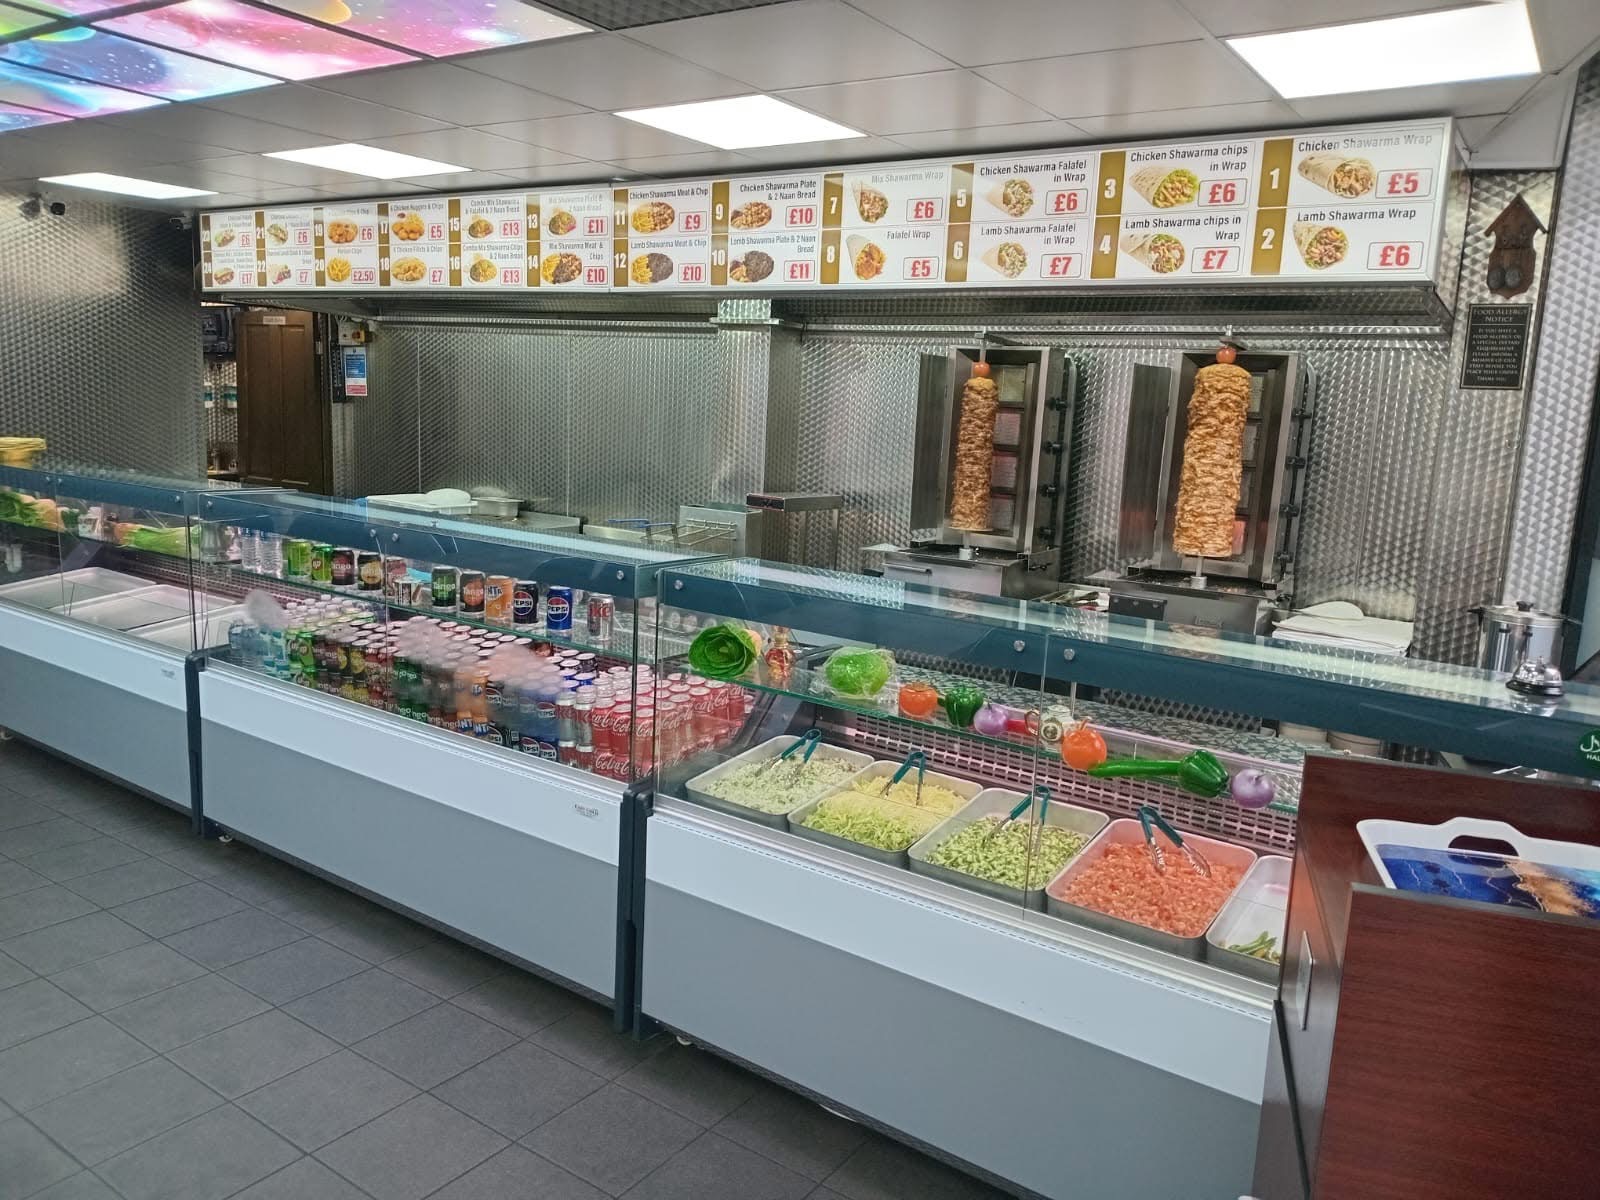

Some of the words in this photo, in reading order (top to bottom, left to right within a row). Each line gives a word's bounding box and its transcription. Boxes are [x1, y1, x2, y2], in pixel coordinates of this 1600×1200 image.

[1298, 141, 1340, 152] Chicken
[1344, 137, 1400, 149] Shawarma
[1404, 135, 1432, 146] Wrap
[1130, 152, 1167, 162] Chicken
[1169, 149, 1218, 160] Shawarma
[1222, 145, 1248, 156] chips
[980, 166, 1011, 176] Chicken
[1013, 164, 1056, 174] Shawarma
[1058, 160, 1087, 170] Falafel
[1210, 162, 1218, 171] in
[1222, 161, 1246, 172] Wrap
[872, 175, 884, 184] Mix
[886, 172, 923, 182] Shawarma
[925, 171, 944, 181] Wrap
[1054, 174, 1062, 182] in
[1064, 173, 1086, 183] Wrap
[1269, 168, 1280, 188] 1
[1388, 172, 1419, 194] £5
[740, 184, 764, 192] Chicken
[766, 182, 799, 191] Shawarma
[800, 180, 816, 188] Plate
[1104, 178, 1117, 199] 3
[1208, 183, 1236, 203] £6
[630, 192, 650, 200] Chicken
[650, 190, 676, 198] Shawarma
[678, 188, 690, 196] Meat
[690, 188, 694, 196] &
[696, 188, 708, 196] Chip
[780, 192, 796, 200] Naan
[797, 190, 816, 199] Bread
[956, 189, 967, 208] 5
[830, 197, 838, 214] 7
[1054, 192, 1078, 212] £6
[715, 203, 724, 220] 9
[790, 208, 813, 225] £10
[914, 201, 934, 219] £6
[1297, 211, 1325, 222] Lamb
[1328, 210, 1384, 221] Shawarma
[1388, 208, 1416, 219] Wrap
[449, 217, 460, 232] 15
[527, 214, 538, 228] 13
[615, 210, 626, 225] 11
[685, 214, 700, 230] £9
[1125, 220, 1150, 229] Lamb
[1152, 218, 1201, 228] Shawarma
[1203, 215, 1229, 227] chips
[1232, 215, 1241, 224] in
[256, 227, 264, 239] 21
[314, 224, 323, 236] 19
[431, 225, 442, 238] £5
[502, 222, 520, 236] £13
[588, 219, 604, 234] £11
[981, 227, 1002, 236] Lamb
[1004, 225, 1046, 235] Shawarma
[1048, 223, 1076, 233] Falafel
[298, 232, 308, 243] £6
[362, 228, 372, 240] £6
[730, 237, 745, 245] Lamb
[746, 236, 775, 245] Shawarma
[776, 235, 790, 243] Plate
[791, 235, 795, 243] &
[801, 234, 816, 243] Naan
[887, 230, 910, 240] Falafel
[912, 230, 931, 240] Wrap
[1044, 236, 1051, 245] in
[1054, 235, 1075, 245] Wrap
[1215, 230, 1240, 240] Wrap
[1261, 228, 1275, 249] 2
[631, 241, 645, 249] Lamb
[646, 240, 674, 248] Shawarma
[675, 240, 688, 248] Meat
[694, 240, 706, 248] Chip
[797, 245, 814, 253] Bread
[953, 241, 964, 259] 6
[1099, 235, 1111, 254] 4
[590, 252, 604, 260] Chips
[614, 253, 627, 268] 12
[712, 250, 726, 266] 10
[826, 245, 835, 263] 8
[1202, 250, 1229, 270] £7
[1379, 244, 1410, 267] £6
[257, 260, 266, 272] 22
[316, 258, 324, 271] 20
[380, 258, 390, 271] 18
[450, 256, 460, 270] 16
[527, 255, 538, 269] 14
[911, 260, 931, 278] £5
[1050, 256, 1072, 275] £7
[300, 272, 308, 282] £7
[353, 270, 374, 282] £2.50
[432, 270, 442, 282] £7
[503, 270, 520, 284] £13
[586, 268, 605, 283] £10
[682, 266, 701, 281] £10
[790, 262, 810, 279] £11
[432, 581, 456, 592] Tango
[1586, 754, 1600, 762] HAL
